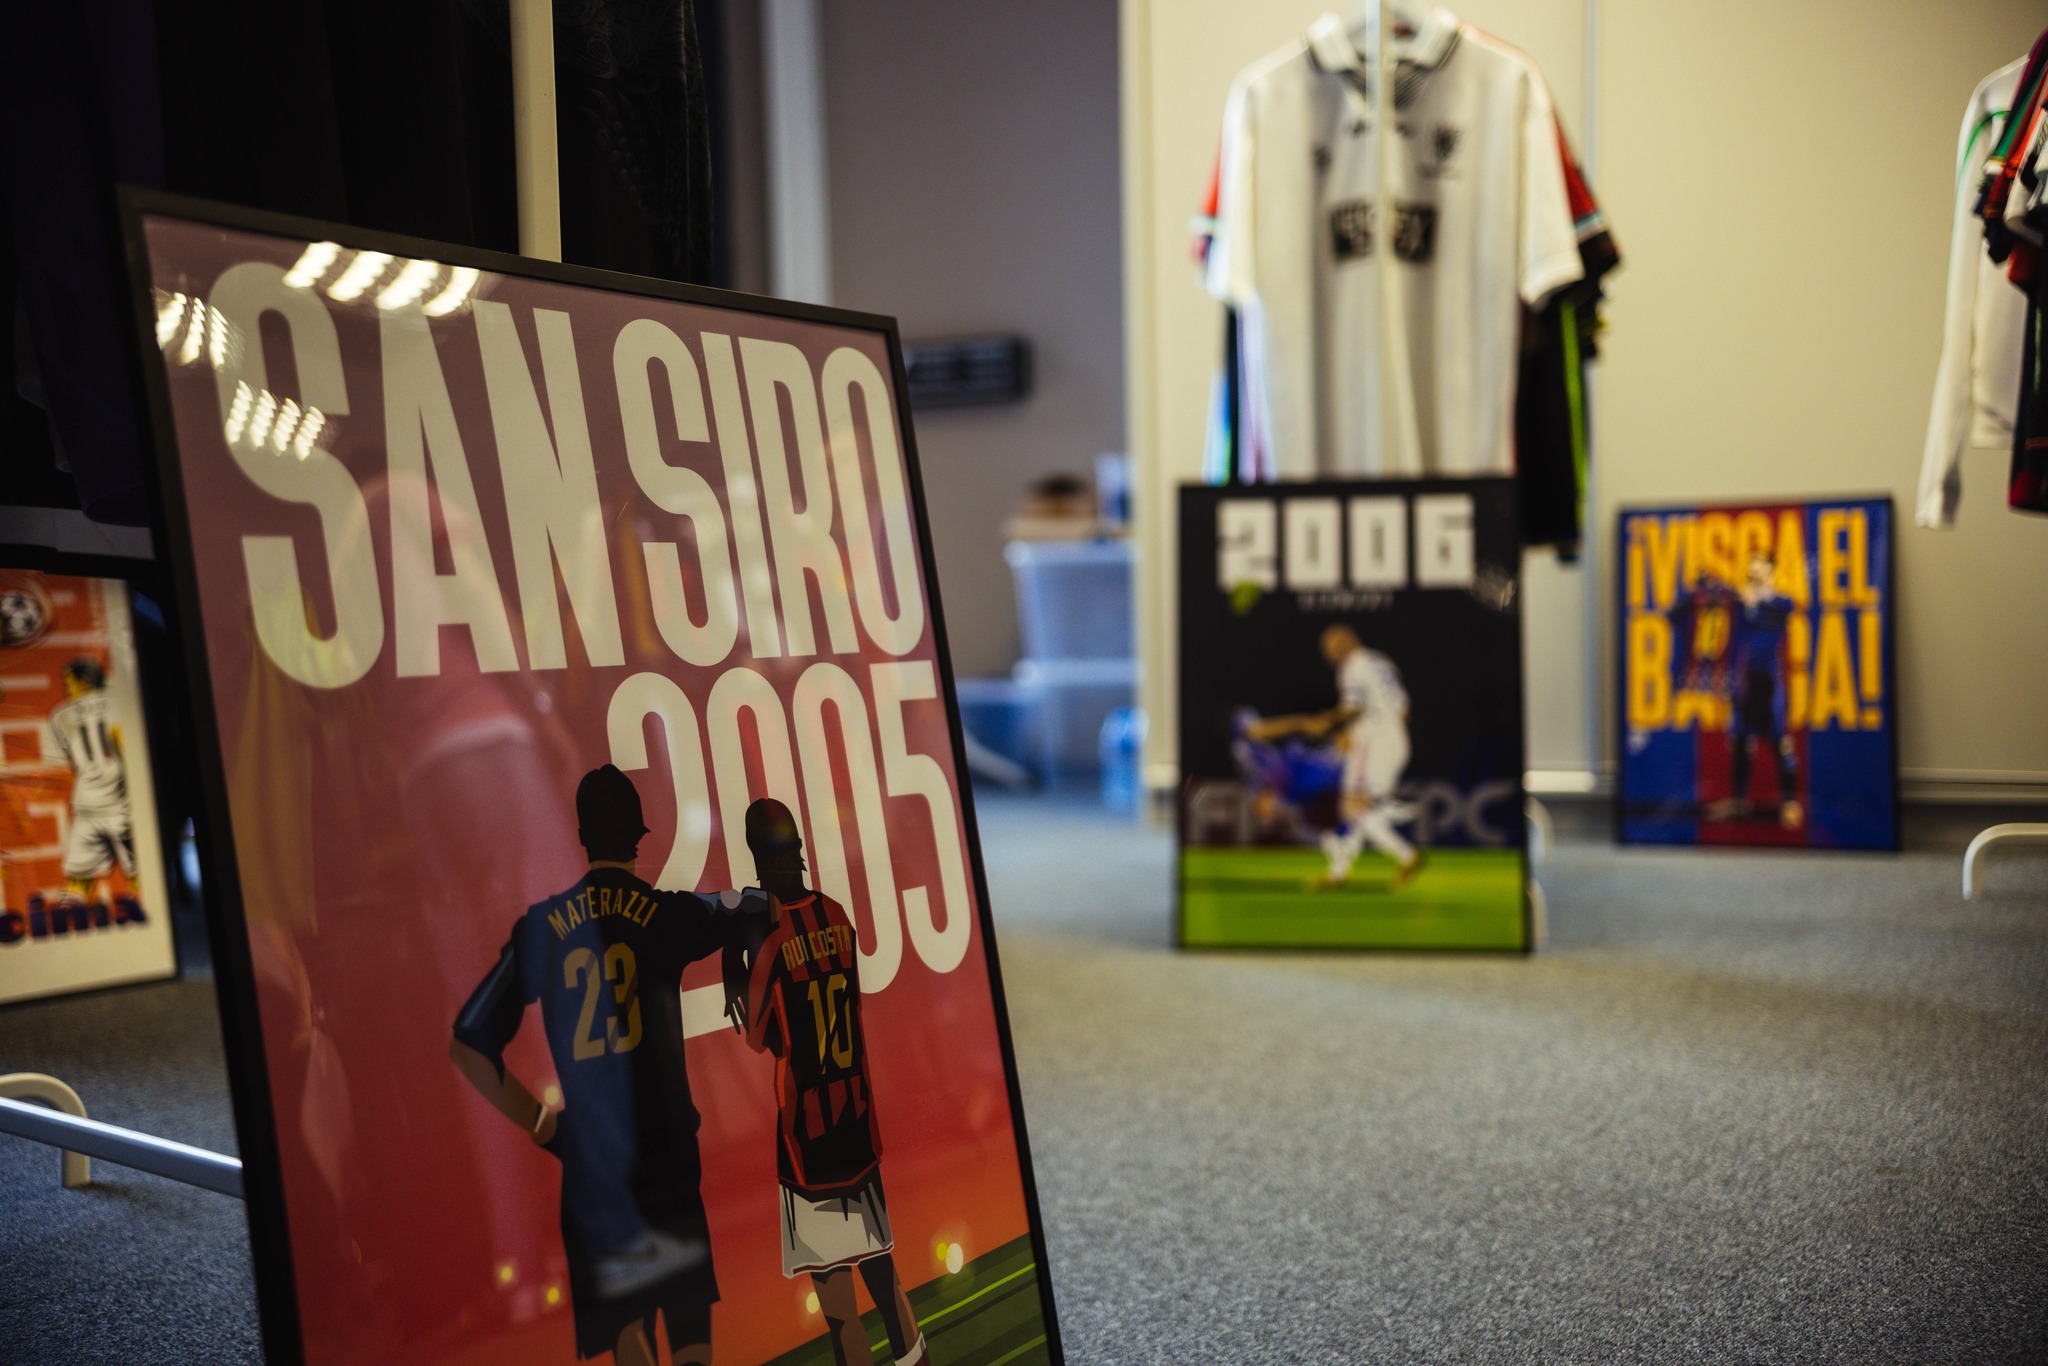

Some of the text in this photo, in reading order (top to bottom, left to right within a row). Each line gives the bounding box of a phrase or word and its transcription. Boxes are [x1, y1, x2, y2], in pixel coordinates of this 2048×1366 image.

[209, 261, 925, 689] SAN SIRO
[1216, 493, 1476, 591] 2006
[1818, 508, 1880, 608] EL
[607, 659, 972, 1040] 2005
[547, 886, 659, 941] MATERAZZI
[563, 942, 644, 1062] 23
[807, 973, 854, 1076] 10
